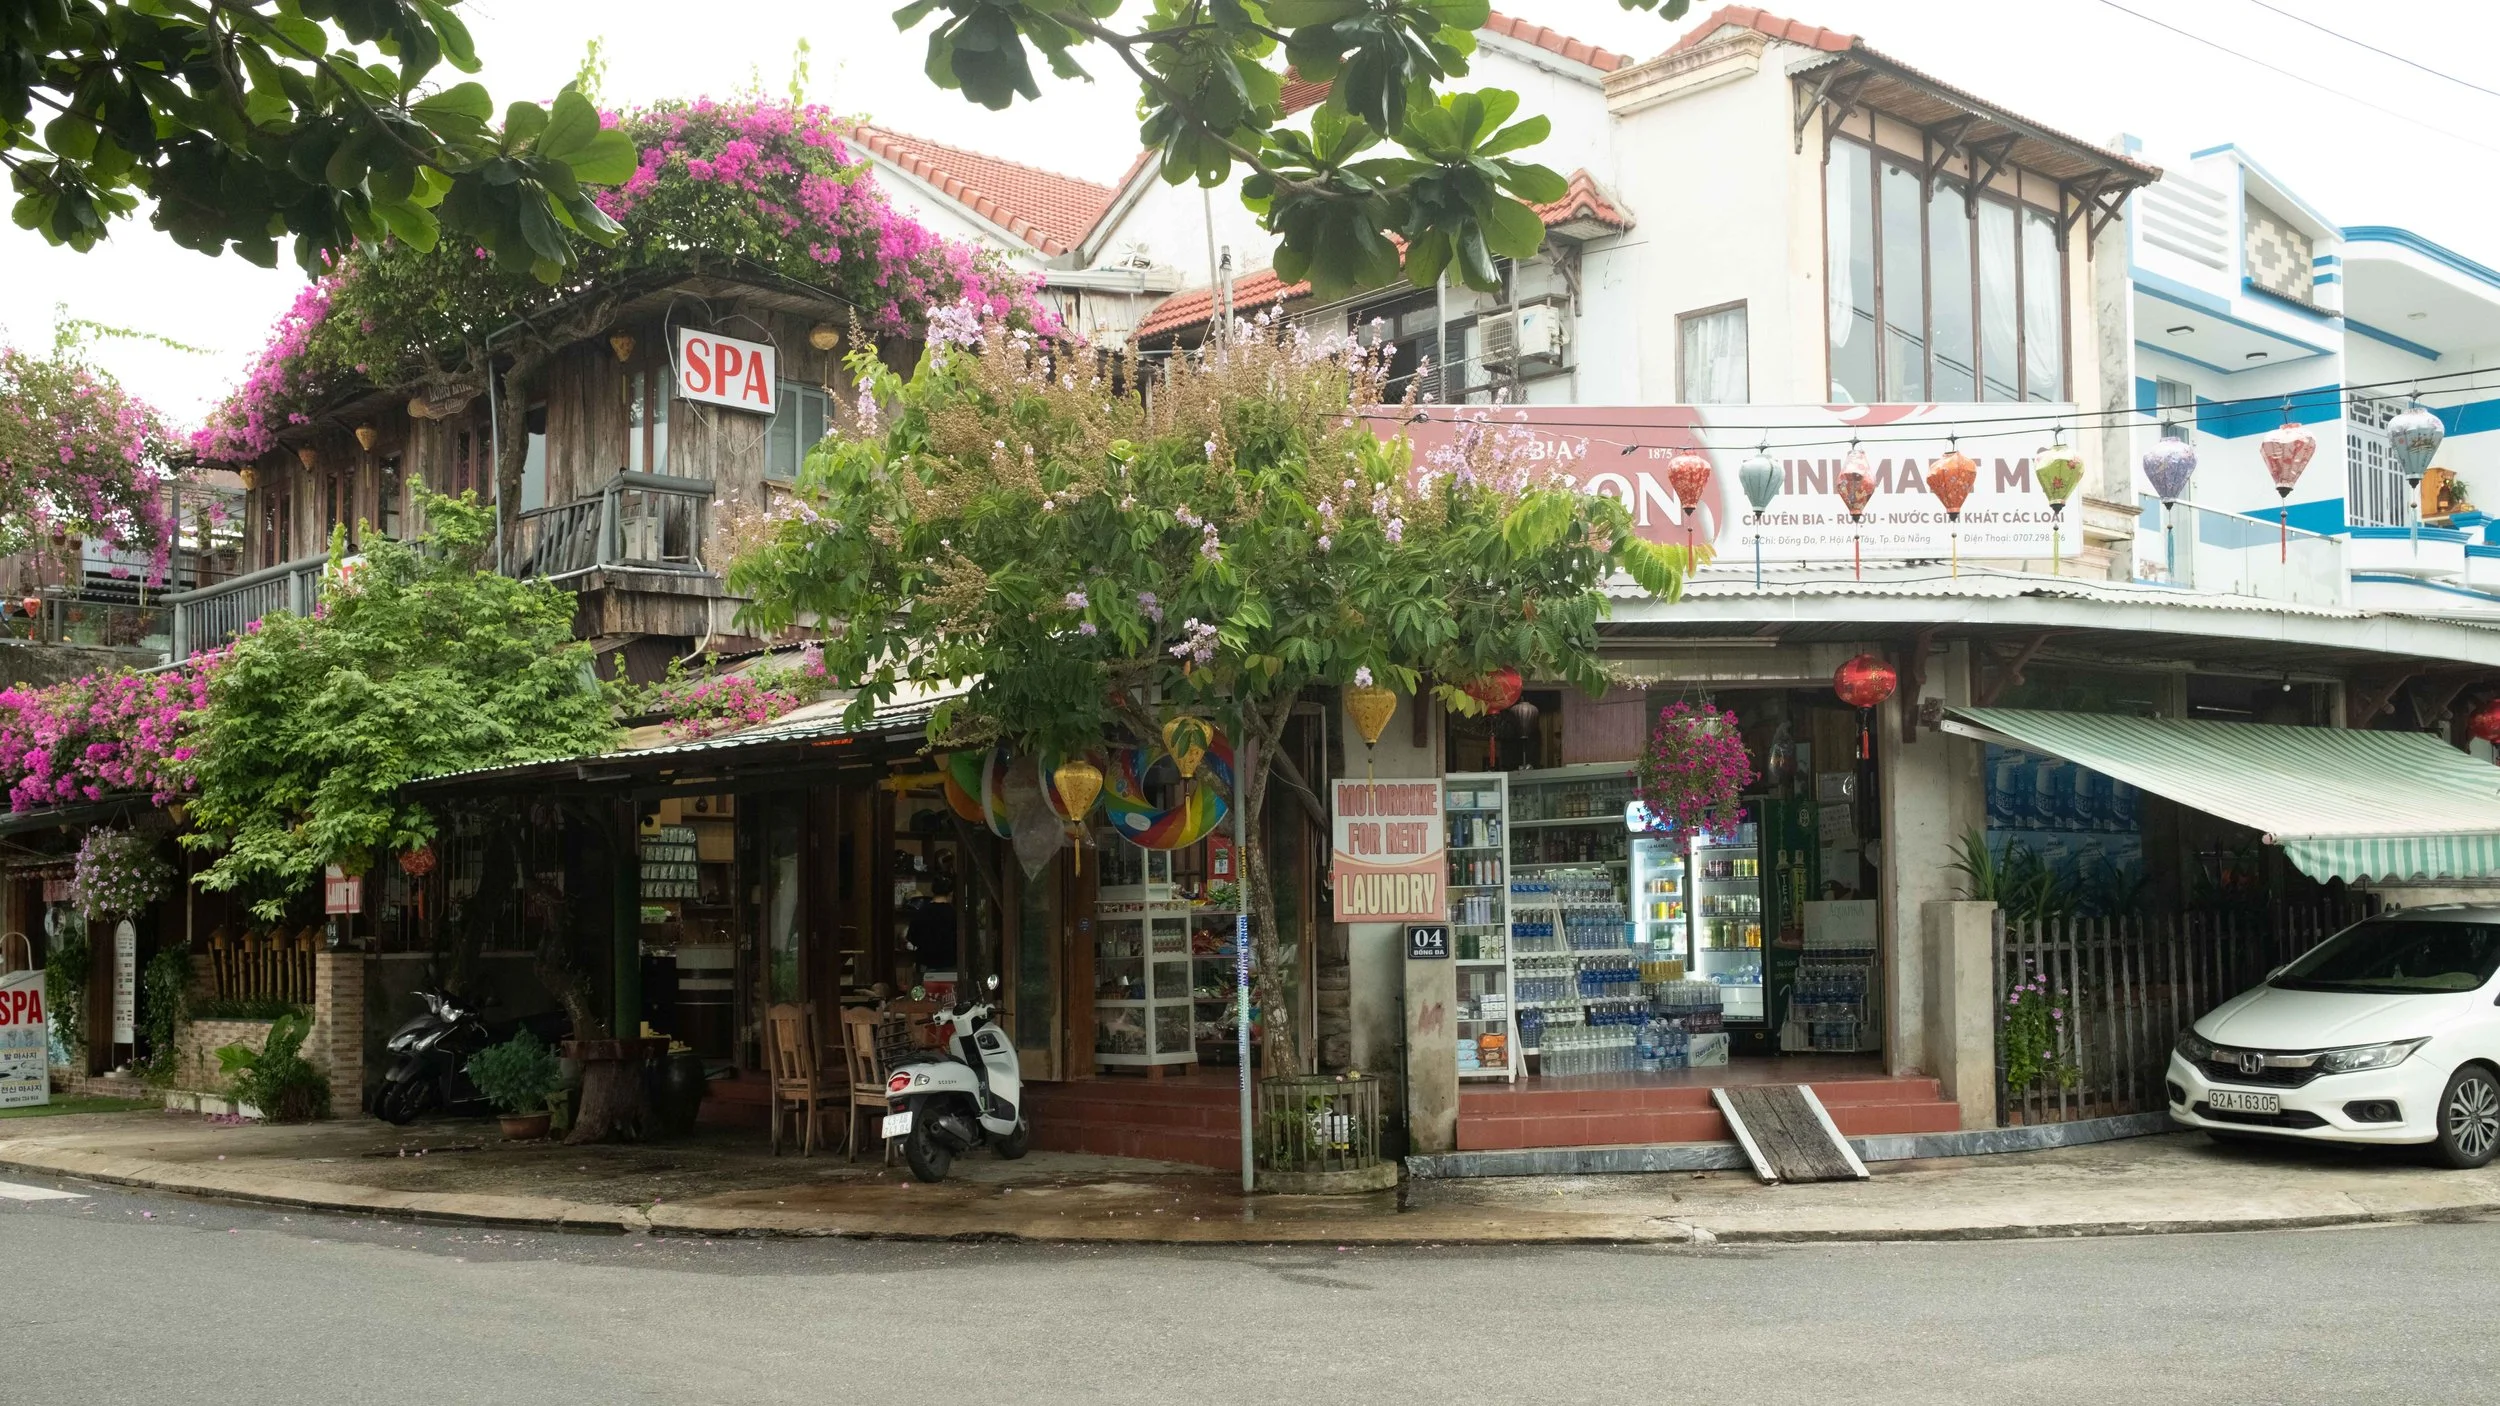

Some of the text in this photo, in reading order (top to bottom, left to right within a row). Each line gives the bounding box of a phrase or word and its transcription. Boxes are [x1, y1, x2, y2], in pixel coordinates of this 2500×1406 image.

[685, 338, 770, 405] SPA
[1529, 440, 1572, 461] BIA
[1648, 448, 1672, 459] 1875
[1742, 511, 1799, 526] CHUYÊN
[1803, 514, 1824, 525] BIA
[1889, 509, 1929, 524] NƯỚC
[1965, 509, 1999, 523] KHÁT
[2003, 509, 2030, 523] CÁC
[1338, 784, 1438, 817] MOTORBIKE
[1348, 822, 1428, 855] FOR RENT
[1341, 872, 1437, 915] LAUNDRY
[327, 924, 337, 937] 04
[1415, 929, 1443, 947] 04
[0, 990, 43, 1026] SPA
[13, 1051, 37, 1060] 마사지
[1, 1084, 42, 1094] 전신 마사지
